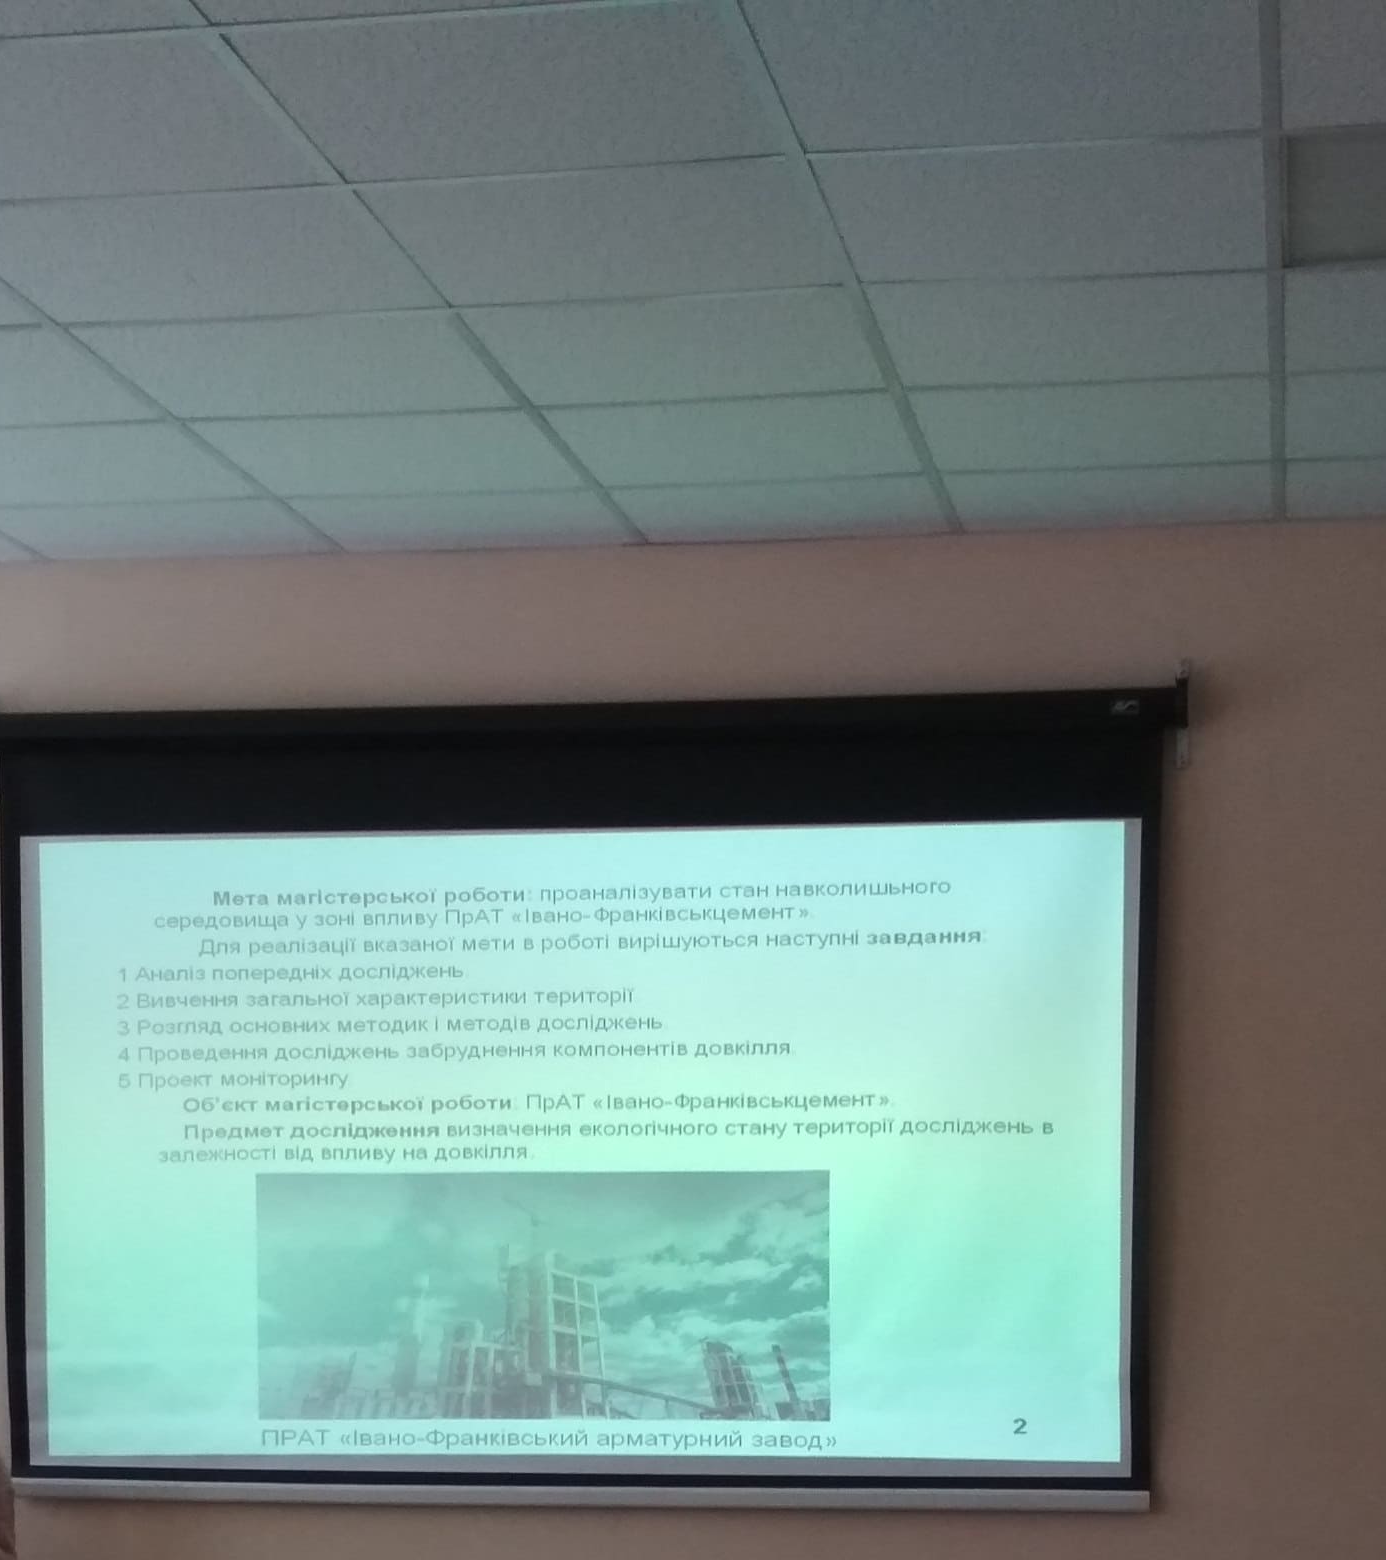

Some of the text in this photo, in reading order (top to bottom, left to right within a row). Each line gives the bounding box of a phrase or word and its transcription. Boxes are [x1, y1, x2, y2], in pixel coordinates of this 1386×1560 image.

[213, 890, 271, 906] Мета
[277, 888, 437, 907] магістерської
[540, 883, 712, 903] проаналізувати
[720, 883, 769, 898] стан
[154, 912, 289, 931] середовища
[296, 913, 308, 930] у
[314, 910, 356, 926] зоні
[364, 910, 438, 929] впливу
[445, 909, 504, 927] ПрАТ
[199, 938, 240, 958] Для
[249, 937, 356, 957] реалізації
[364, 935, 453, 953] вказаної
[462, 936, 515, 952] мети
[523, 936, 534, 951] в
[541, 931, 610, 953] роботі
[618, 930, 759, 952] вирішуються
[766, 930, 860, 949] наступні
[118, 967, 127, 982] 1
[135, 965, 206, 981] Аналіз
[212, 965, 332, 983] попередніх
[117, 988, 634, 1009] 2 Вивчення загальної характеристики території
[117, 1019, 130, 1036] 3
[137, 1018, 223, 1037] Розгляд
[230, 1018, 330, 1033] основних
[337, 1016, 428, 1035] методик
[447, 1015, 530, 1033] методів
[118, 1046, 130, 1062] 4
[138, 1045, 268, 1064] Проведення
[274, 1044, 399, 1062] досліджень
[406, 1041, 545, 1061] забруднення
[553, 1040, 688, 1058] компонентів
[118, 1069, 349, 1090] 5 Проект моніторингу
[265, 1096, 424, 1114] магістерської
[526, 1094, 586, 1113] ПрАТ
[183, 1117, 1054, 1142] Предмет дослідження визначення екологічного стану території досліджень в
[159, 1145, 276, 1164] залежності
[285, 1145, 314, 1163] від
[321, 1145, 396, 1164] впливу
[403, 1145, 427, 1161] на
[1012, 1417, 1028, 1436] 2
[260, 1428, 332, 1449] ПРАТ
[597, 1429, 742, 1452] арматурний
[752, 1430, 837, 1450] завод»
